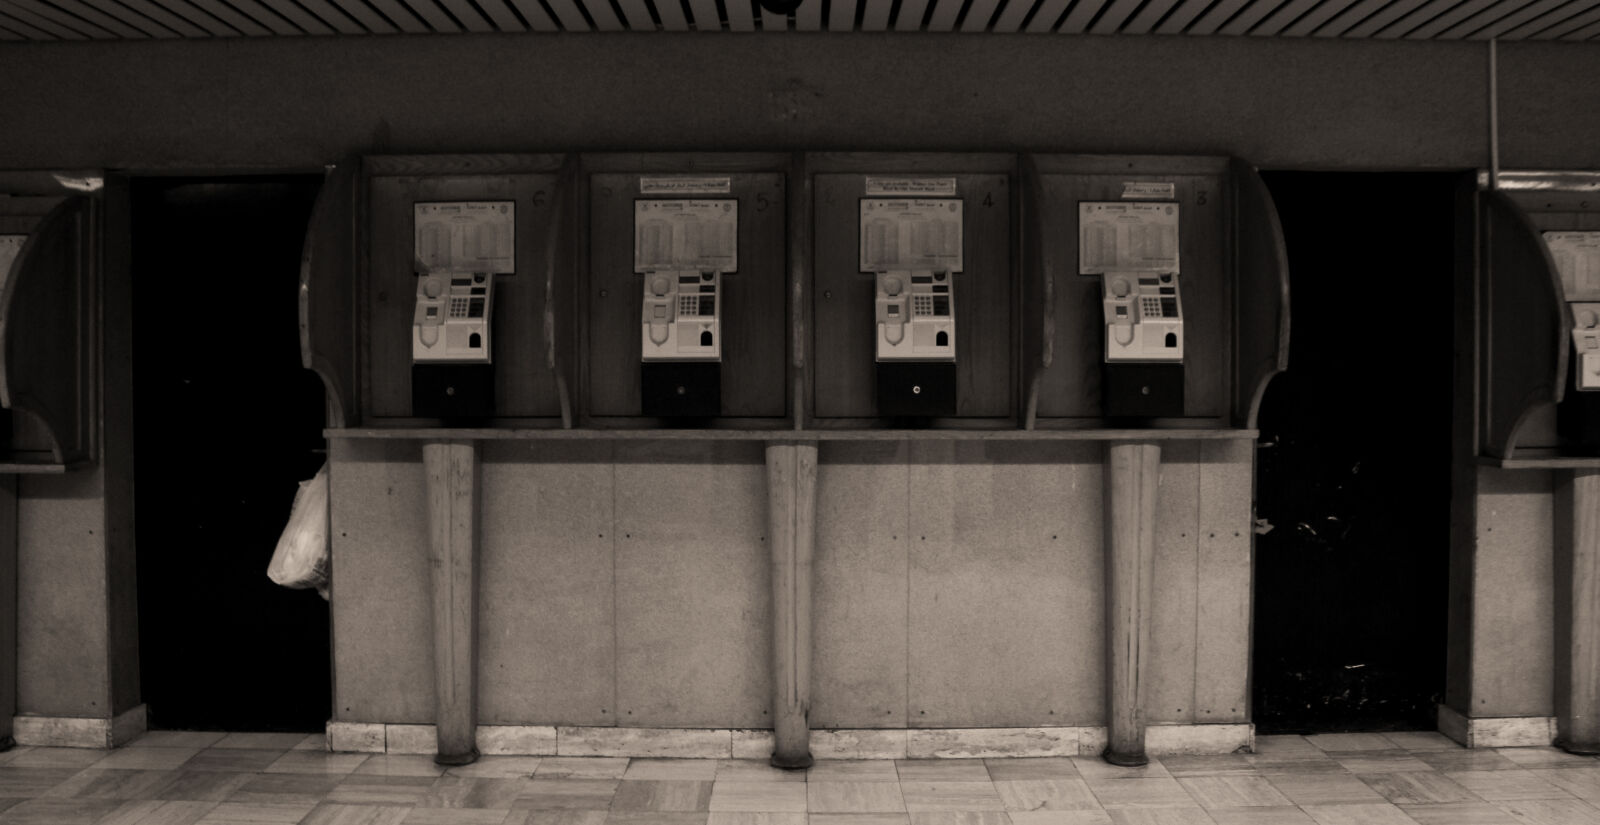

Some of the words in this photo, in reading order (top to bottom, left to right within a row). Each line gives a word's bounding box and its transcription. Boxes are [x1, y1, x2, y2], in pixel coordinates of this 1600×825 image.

[532, 190, 546, 207] 6
[757, 192, 769, 212] 5
[982, 192, 995, 208] 4
[1197, 191, 1208, 206] 3
